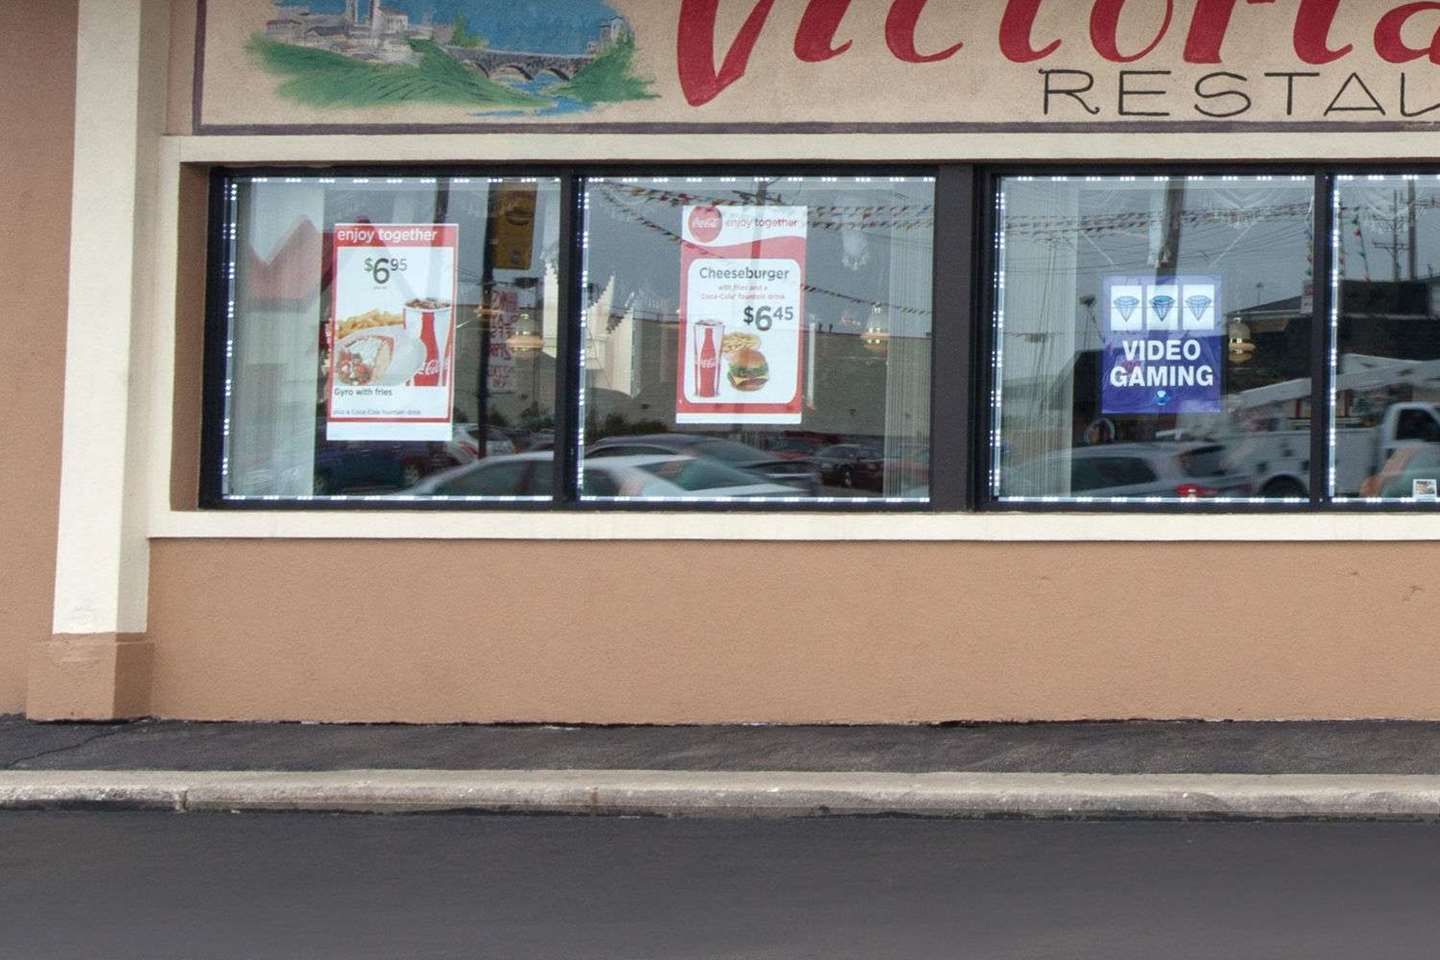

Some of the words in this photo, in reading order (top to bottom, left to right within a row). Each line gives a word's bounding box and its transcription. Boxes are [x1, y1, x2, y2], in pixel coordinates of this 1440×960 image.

[725, 217, 753, 229] enjoy
[754, 217, 798, 229] together
[336, 228, 375, 244] enjoy
[378, 227, 438, 243] together
[699, 266, 790, 281] Cheeseburger
[1122, 339, 1201, 361] VIDEO
[1110, 365, 1214, 387] GAMING
[334, 388, 354, 398] Gyro
[355, 387, 373, 396] with
[374, 387, 393, 396] fries
